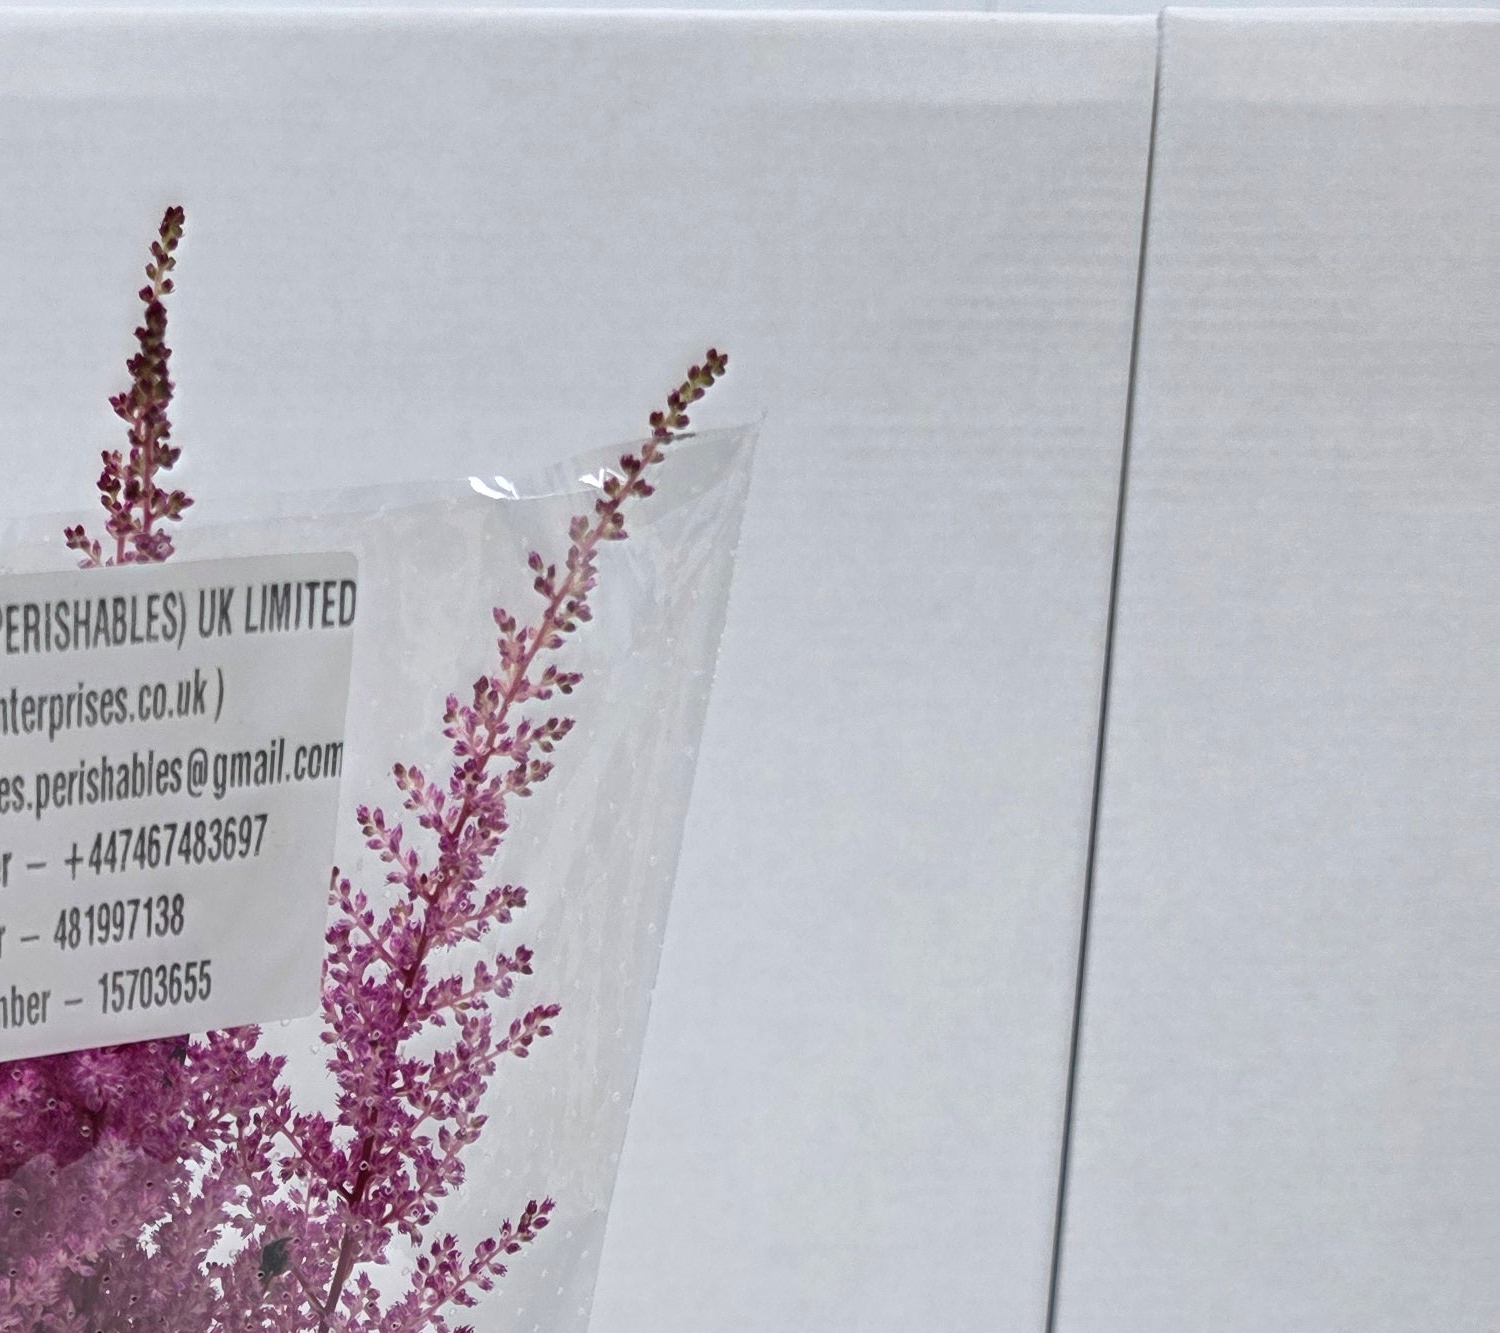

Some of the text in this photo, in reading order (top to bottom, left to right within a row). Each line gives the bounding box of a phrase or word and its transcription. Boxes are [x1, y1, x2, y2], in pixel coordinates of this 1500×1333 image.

[199, 588, 234, 638] UK
[245, 579, 357, 633] LIMITED
[54, 893, 184, 950] 481997138
[98, 959, 211, 1014] 15703655
